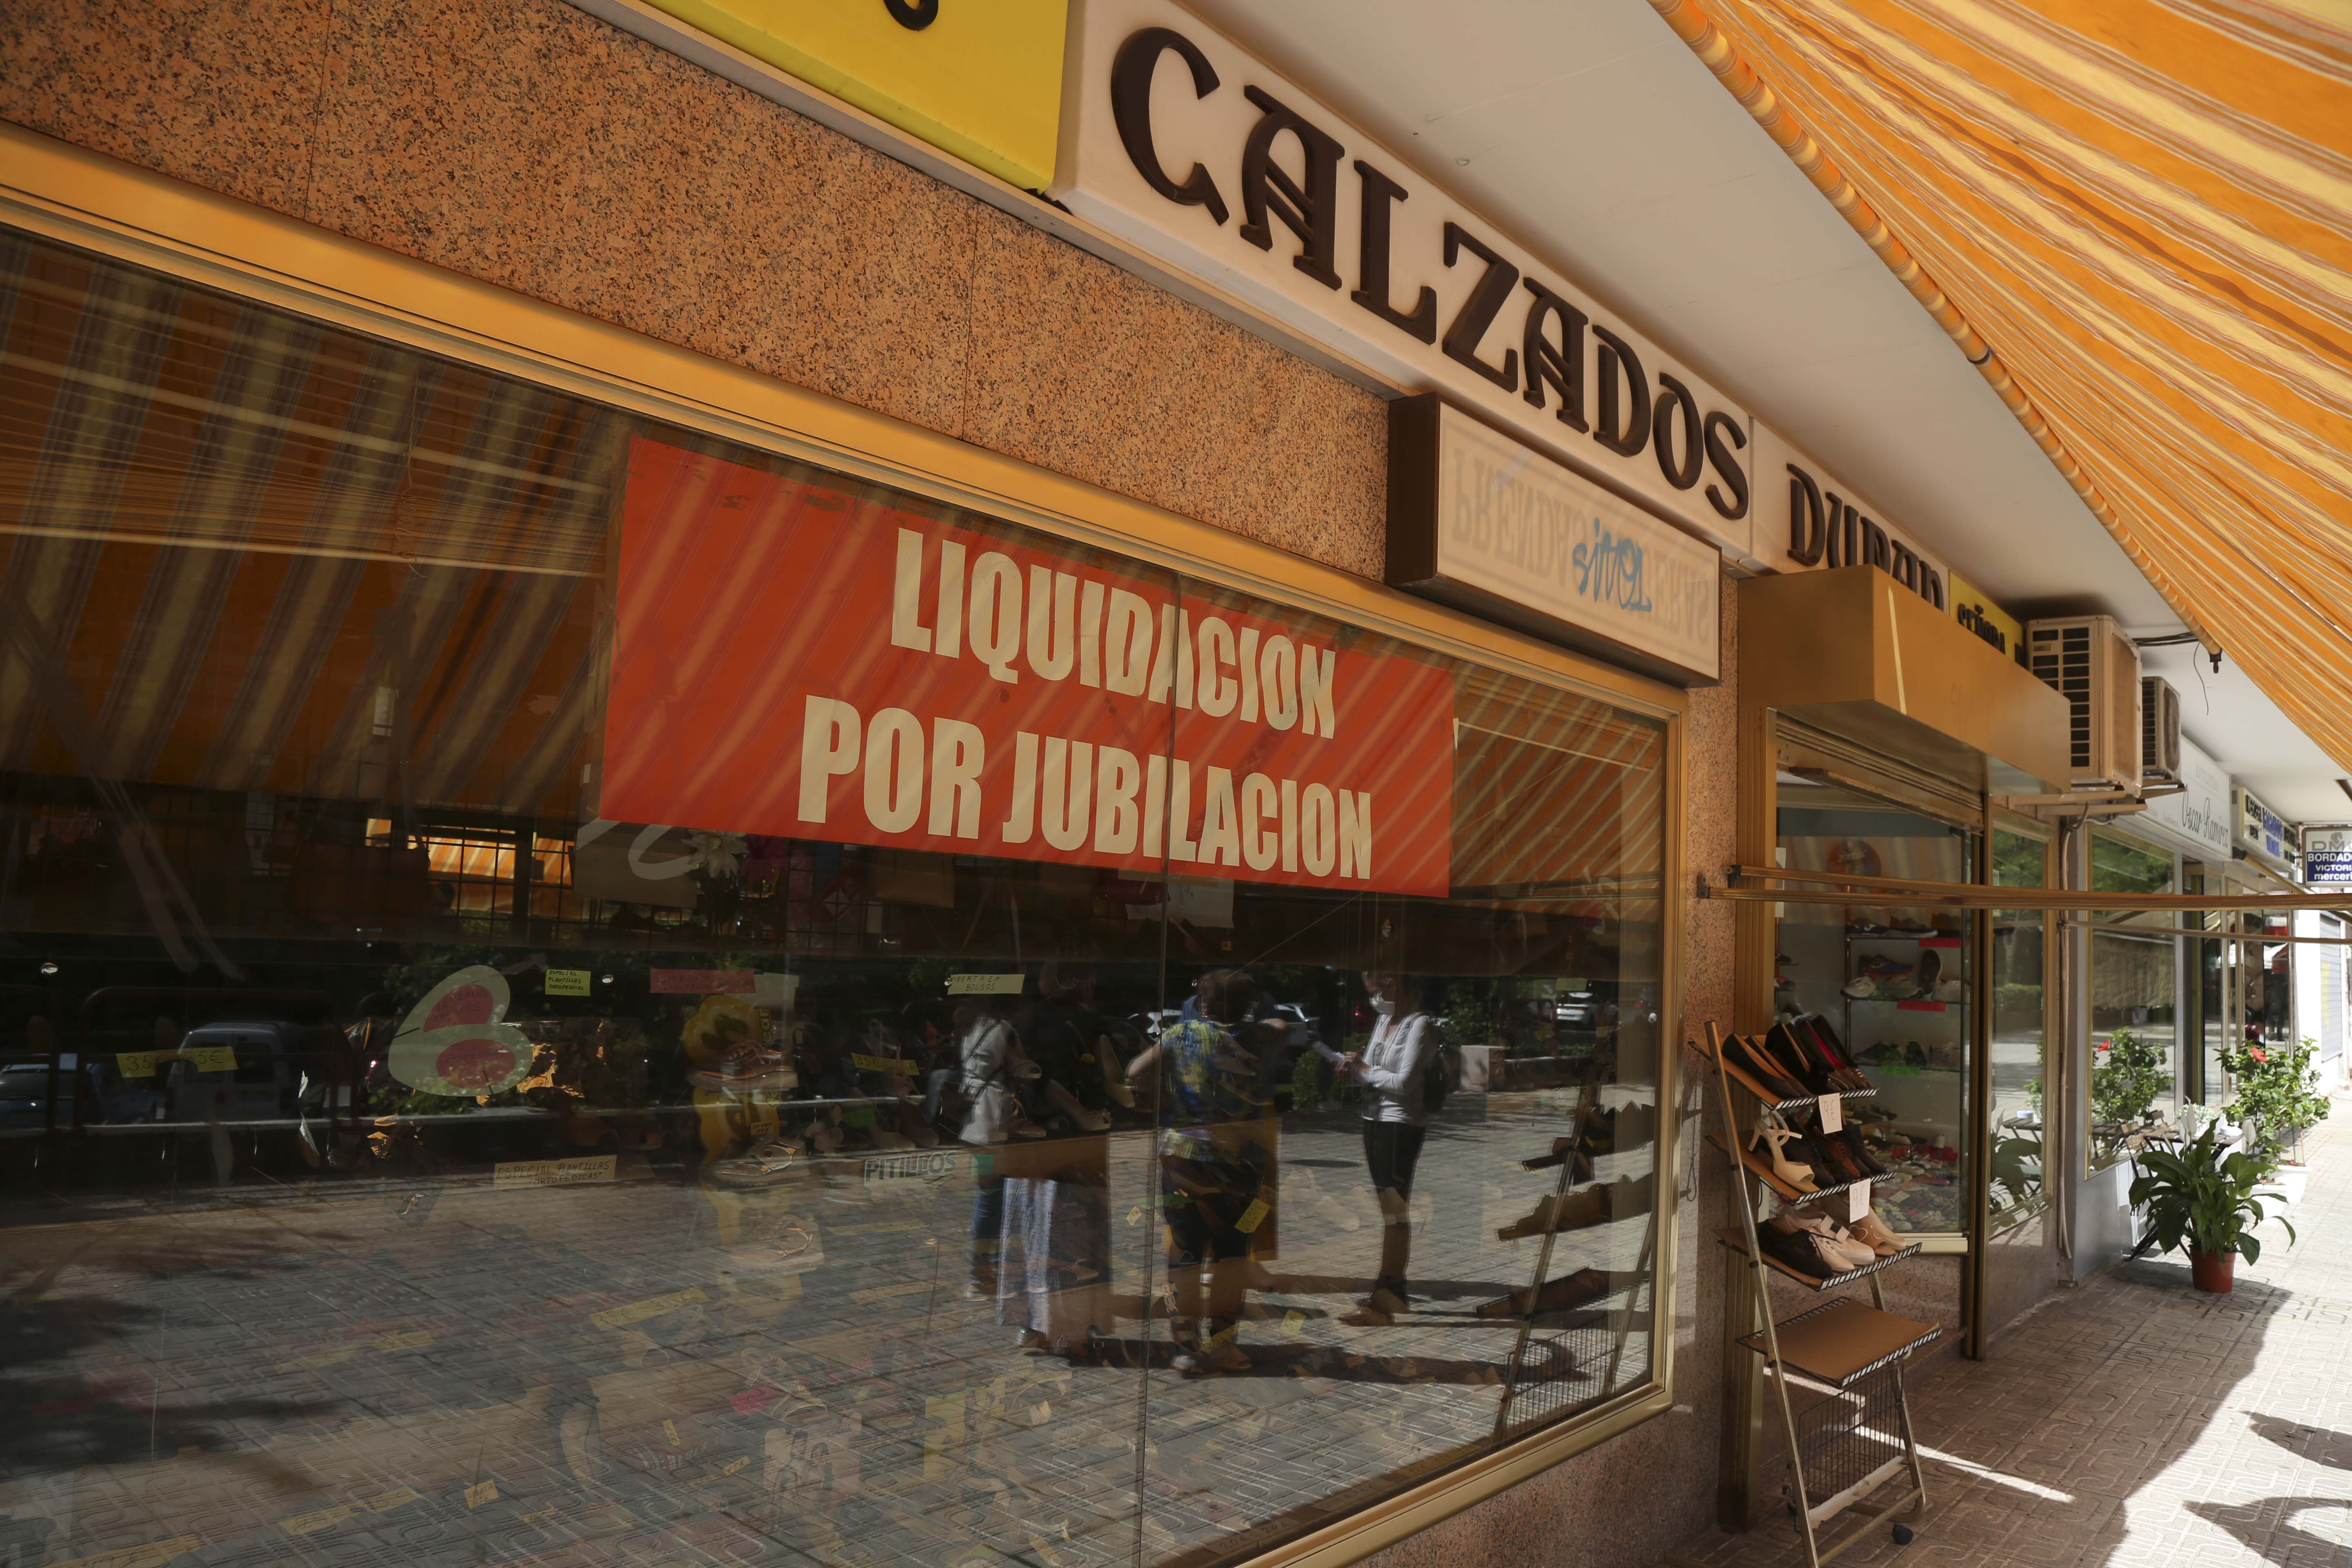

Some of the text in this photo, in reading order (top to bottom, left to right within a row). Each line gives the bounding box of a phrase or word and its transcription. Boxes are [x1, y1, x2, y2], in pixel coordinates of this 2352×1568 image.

[1110, 26, 1749, 519] CALZADOS
[891, 527, 1336, 739] LIQUIDACION
[797, 695, 1372, 880] POR JUBILACION
[2182, 784, 2202, 833] Oscar
[2308, 853, 2352, 862] BORDAD
[951, 975, 984, 984] OFERTA
[965, 983, 996, 991] BOLSOS
[1824, 1099, 1836, 1121] 9€
[557, 1160, 609, 1174] PLANTILLAS
[864, 1150, 955, 1181] PITILLOS
[1853, 1185, 1864, 1207] 9€
